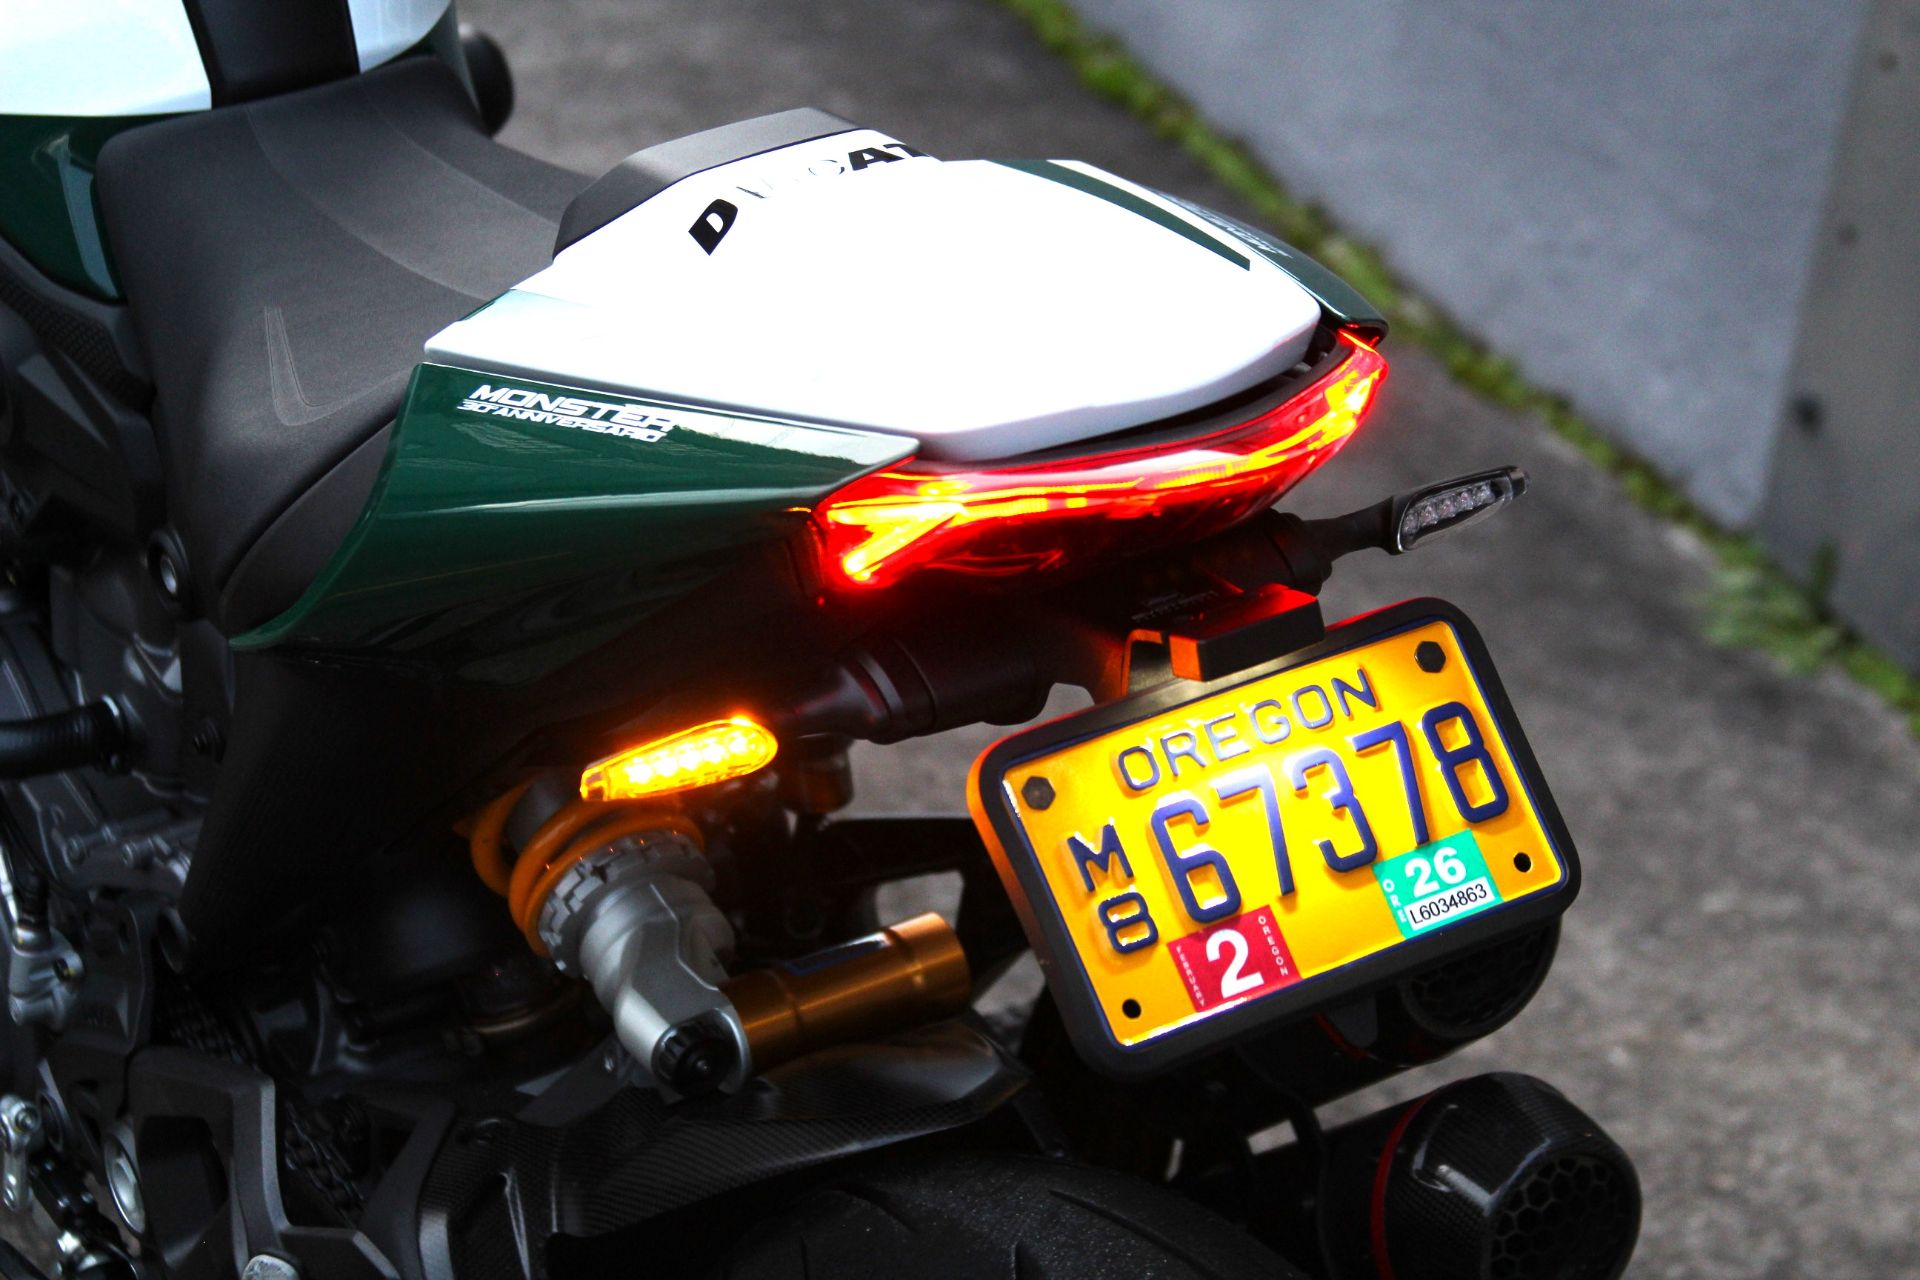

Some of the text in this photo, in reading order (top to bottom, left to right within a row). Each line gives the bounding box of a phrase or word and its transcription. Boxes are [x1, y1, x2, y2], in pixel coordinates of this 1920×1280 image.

[469, 384, 680, 433] MONSTER
[1117, 668, 1378, 791] OREGON
[1151, 701, 1510, 924] 67378
[1404, 846, 1467, 898] 26
[1409, 883, 1487, 924] L6034863
[1206, 928, 1265, 999] 2
[1258, 915, 1289, 977] OREGON
